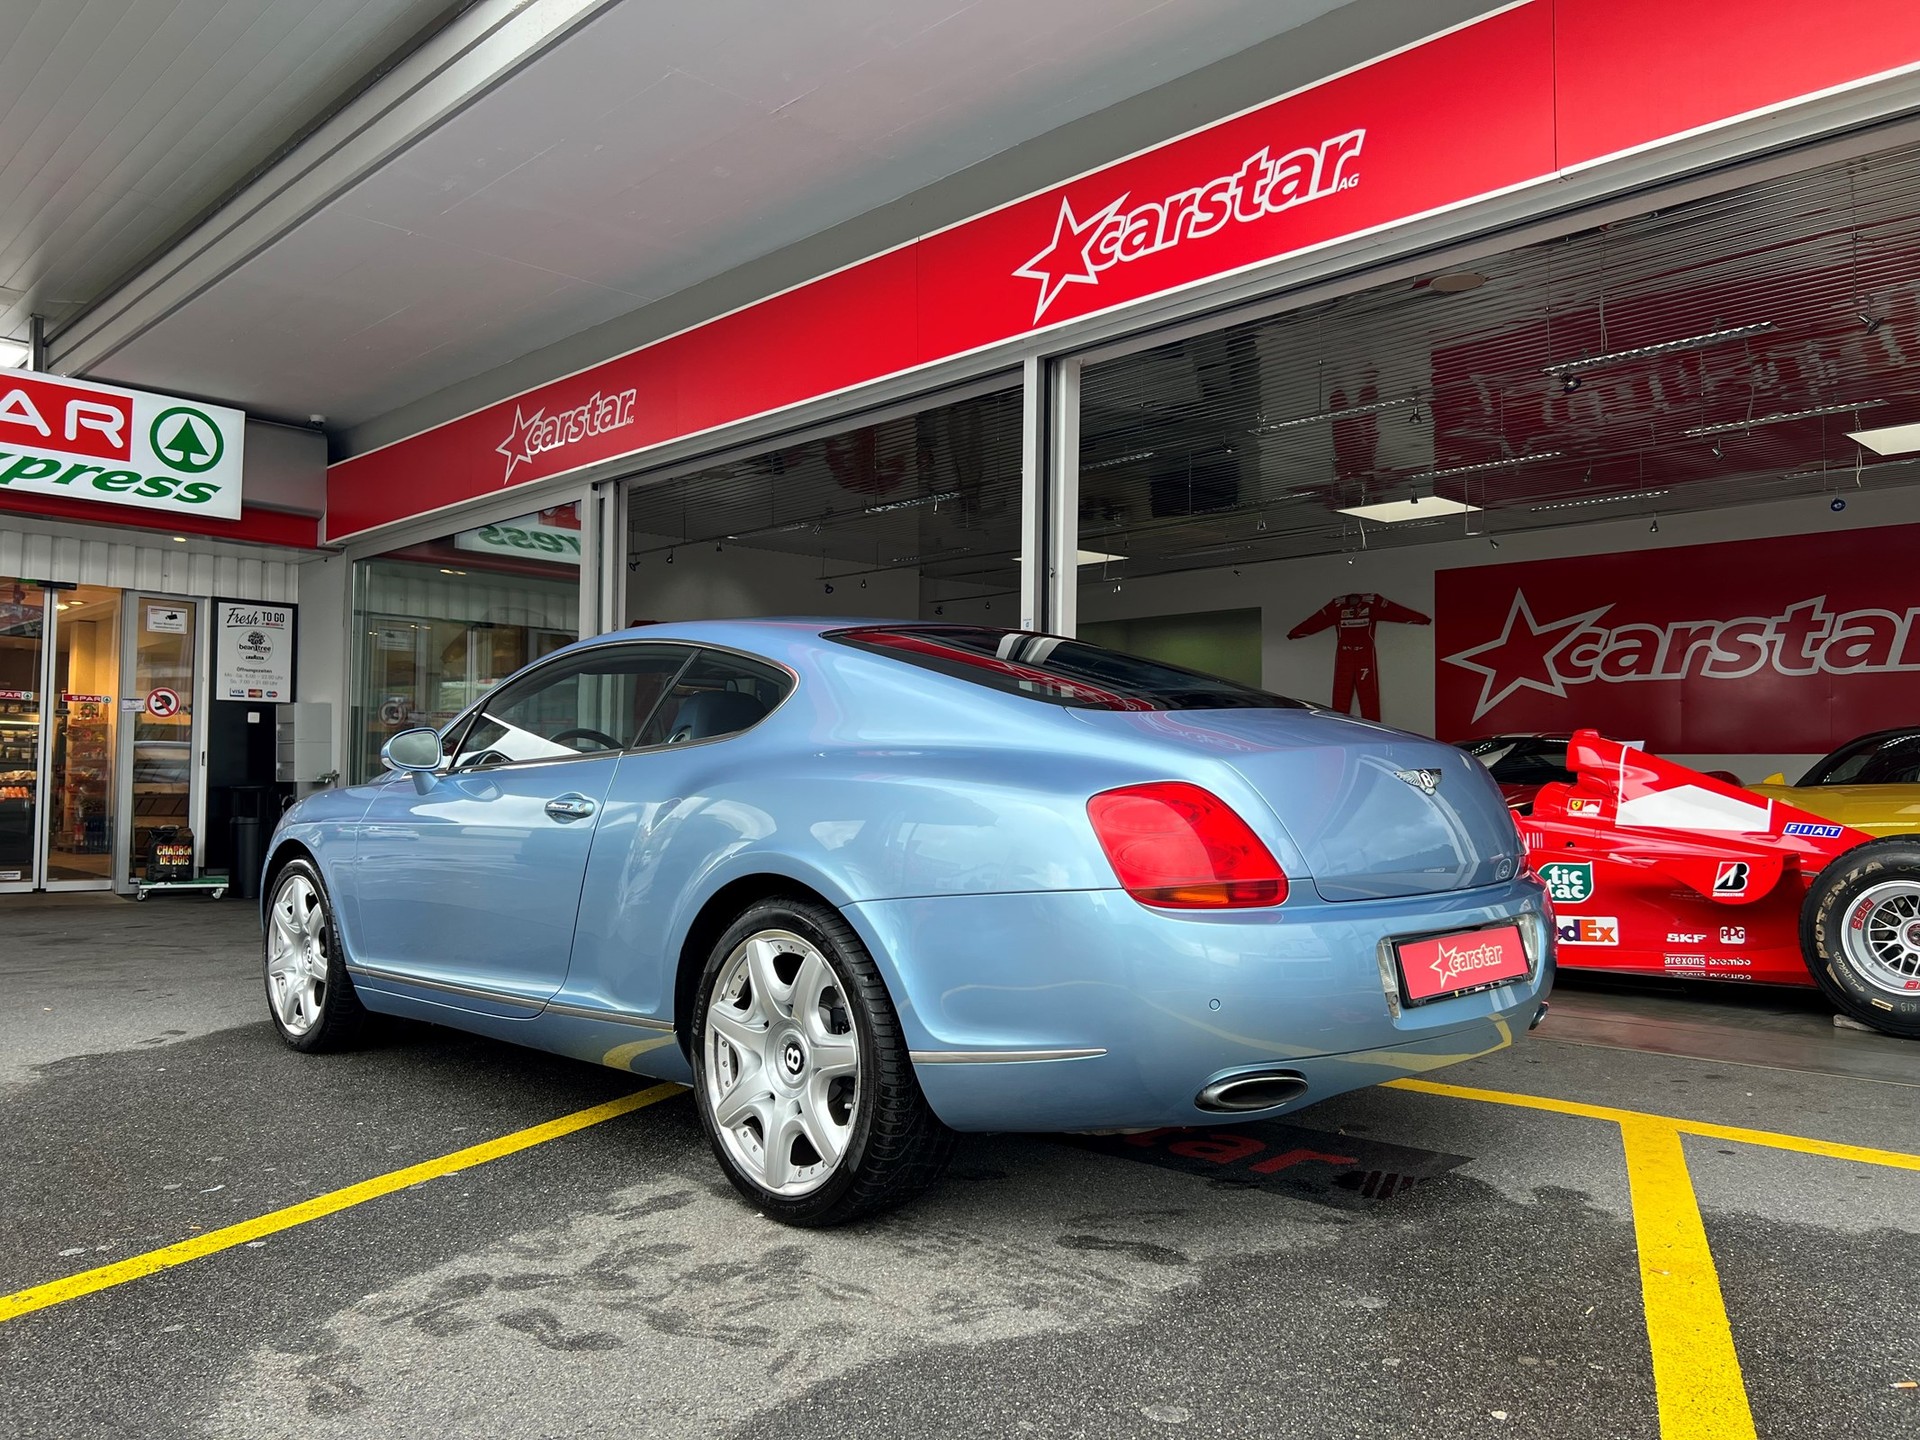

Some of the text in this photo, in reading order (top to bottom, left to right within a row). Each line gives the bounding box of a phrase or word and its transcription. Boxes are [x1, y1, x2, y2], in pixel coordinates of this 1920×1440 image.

[1084, 129, 1366, 271] carstar AG
[526, 389, 637, 456] carstar
[226, 607, 260, 625] Fresh
[262, 611, 272, 621] TO
[274, 613, 285, 623] GO
[1360, 668, 1369, 680] 7
[1785, 823, 1841, 837] FIAT
[156, 845, 192, 856] CHARBON
[160, 855, 189, 866] DE BOIS
[1548, 865, 1583, 885] tic
[1548, 879, 1585, 899] tac
[1814, 861, 1885, 960] POTENZA
[1666, 933, 1707, 943] SKF
[1720, 928, 1745, 941] PPG
[1449, 943, 1503, 974] carstar
[1664, 956, 1706, 966] arexons
[1708, 956, 1752, 966] brembo
